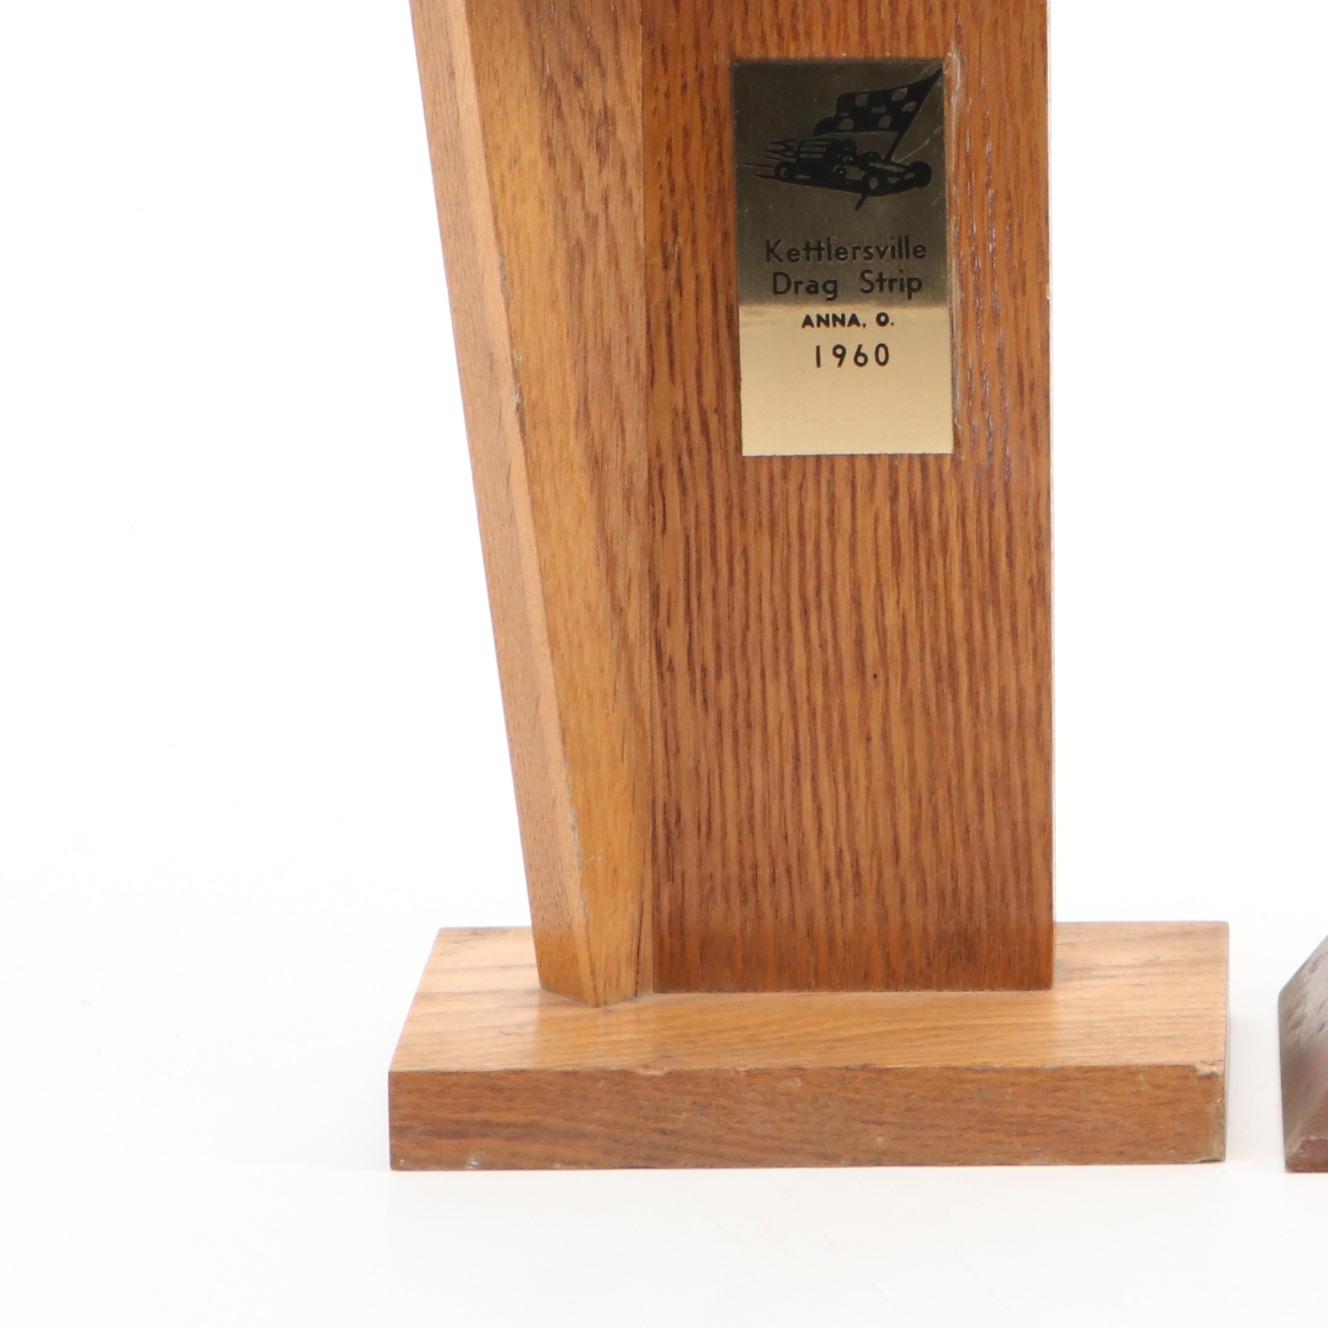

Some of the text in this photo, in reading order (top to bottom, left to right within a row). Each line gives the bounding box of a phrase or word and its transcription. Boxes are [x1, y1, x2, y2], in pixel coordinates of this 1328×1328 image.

[765, 234, 927, 263] Kettlersville
[772, 268, 924, 301] Drag Strip
[801, 312, 895, 329] ANNA, O.
[815, 342, 890, 369] 1960
